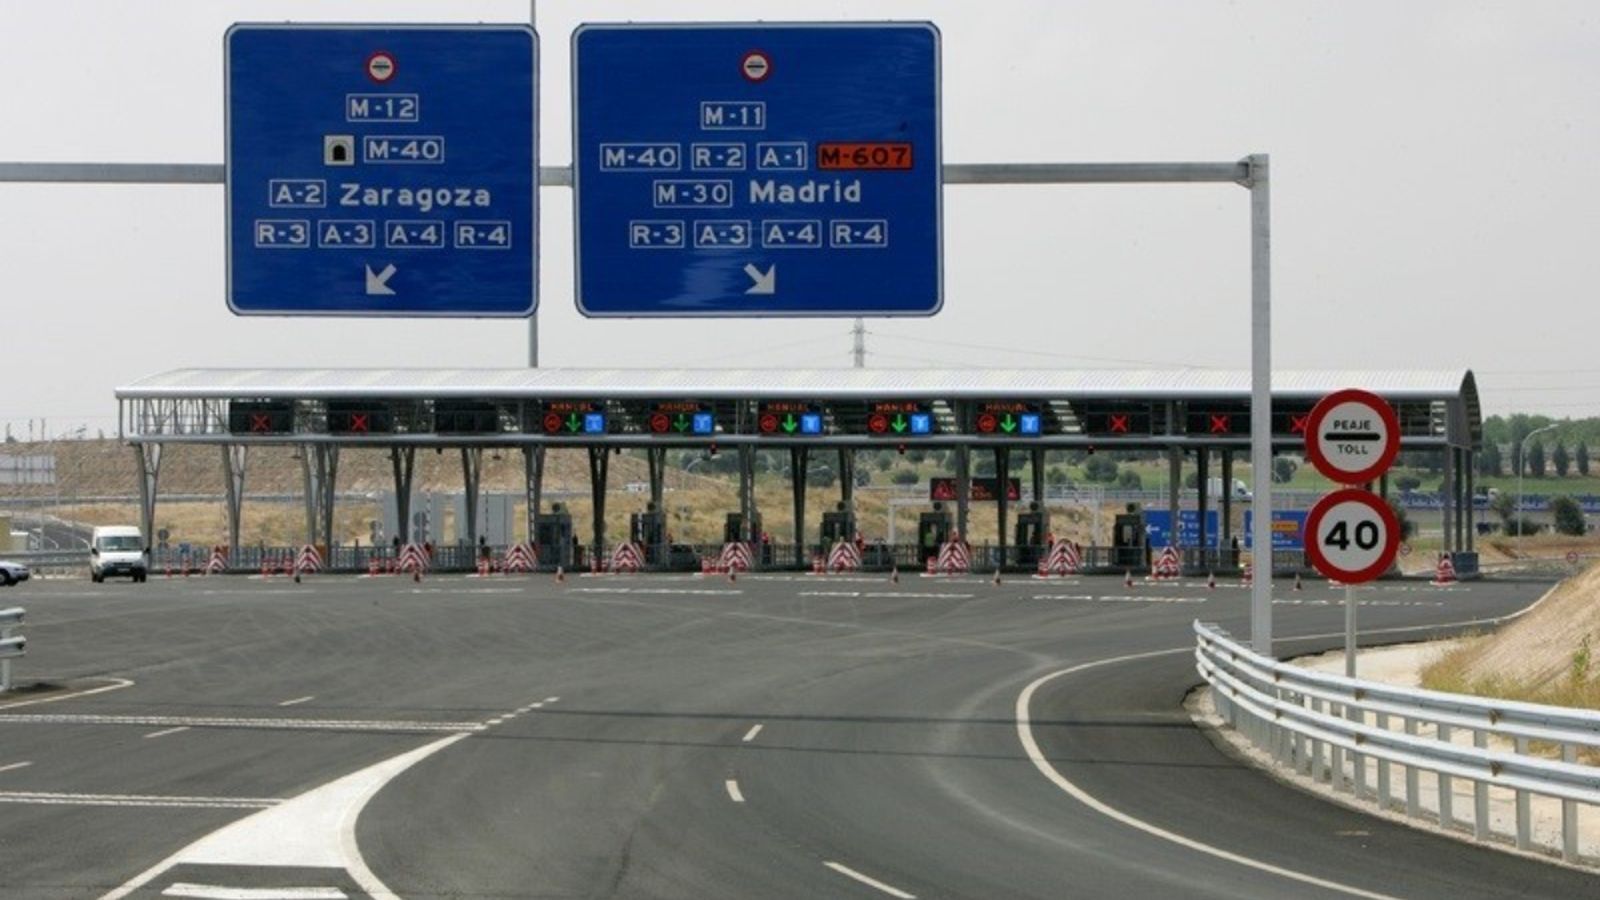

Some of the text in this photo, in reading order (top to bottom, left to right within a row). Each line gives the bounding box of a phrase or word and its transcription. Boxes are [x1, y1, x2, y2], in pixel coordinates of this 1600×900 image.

[351, 99, 414, 117] M-12
[705, 107, 761, 124] M-11
[369, 141, 439, 159] M-40
[606, 147, 908, 166] M-40 R-2 A-1 M-607
[275, 183, 490, 212] A-2 Zaragoza
[658, 180, 860, 203] M-30 Madrid
[258, 224, 505, 244] R-3 A-3 A-4 R-4
[633, 225, 882, 244] R-3 A-3 A-4 R-4
[1333, 420, 1371, 431] PEAJE
[1337, 444, 1368, 455] TOLL
[1324, 520, 1379, 550] 40
